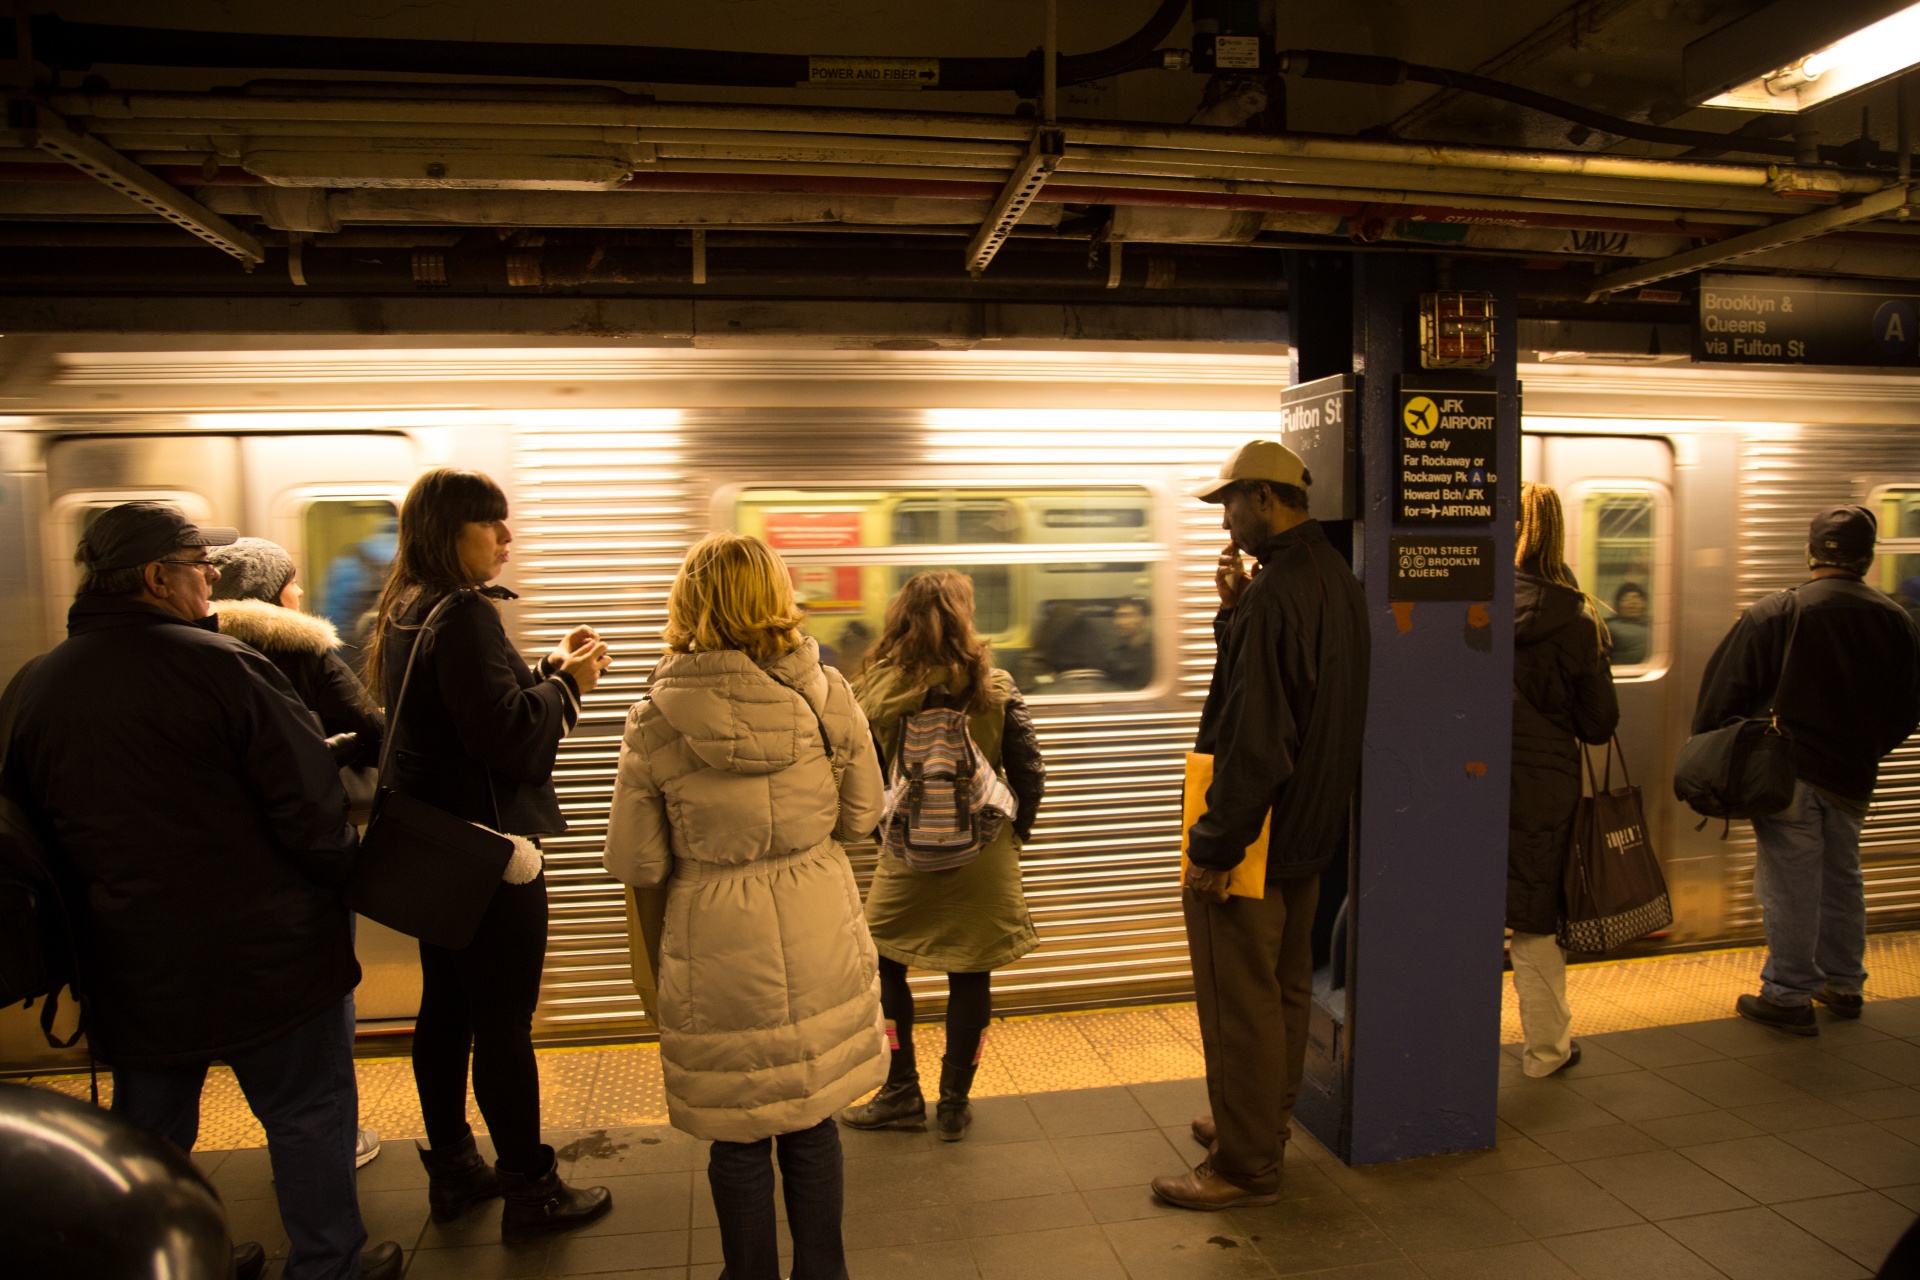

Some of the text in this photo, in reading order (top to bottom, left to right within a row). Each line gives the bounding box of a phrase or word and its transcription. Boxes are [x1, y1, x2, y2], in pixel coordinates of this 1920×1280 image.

[812, 68, 917, 80] POWER AND FIBER
[1705, 293, 1775, 315] Brooklyn
[1781, 296, 1793, 313] &
[1883, 312, 1905, 342] A
[1705, 315, 1767, 334] Queens
[1705, 338, 1805, 357] via Fulton St
[1440, 399, 1465, 413] JFK
[1281, 397, 1342, 434] Fulton St
[1440, 416, 1495, 430] AIRPORT
[1403, 437, 1451, 451] Take only
[1403, 455, 1485, 469] Far Rockaway or
[1403, 471, 1497, 485] Rockaway Pk A to
[1404, 488, 1485, 501] Howard Bch/JFK
[1404, 505, 1491, 517] for AIRTRAIN
[1399, 546, 1478, 556] FULTON STREET
[1428, 557, 1481, 566] BROOKLYN
[1398, 569, 1450, 578] & QUEENS
